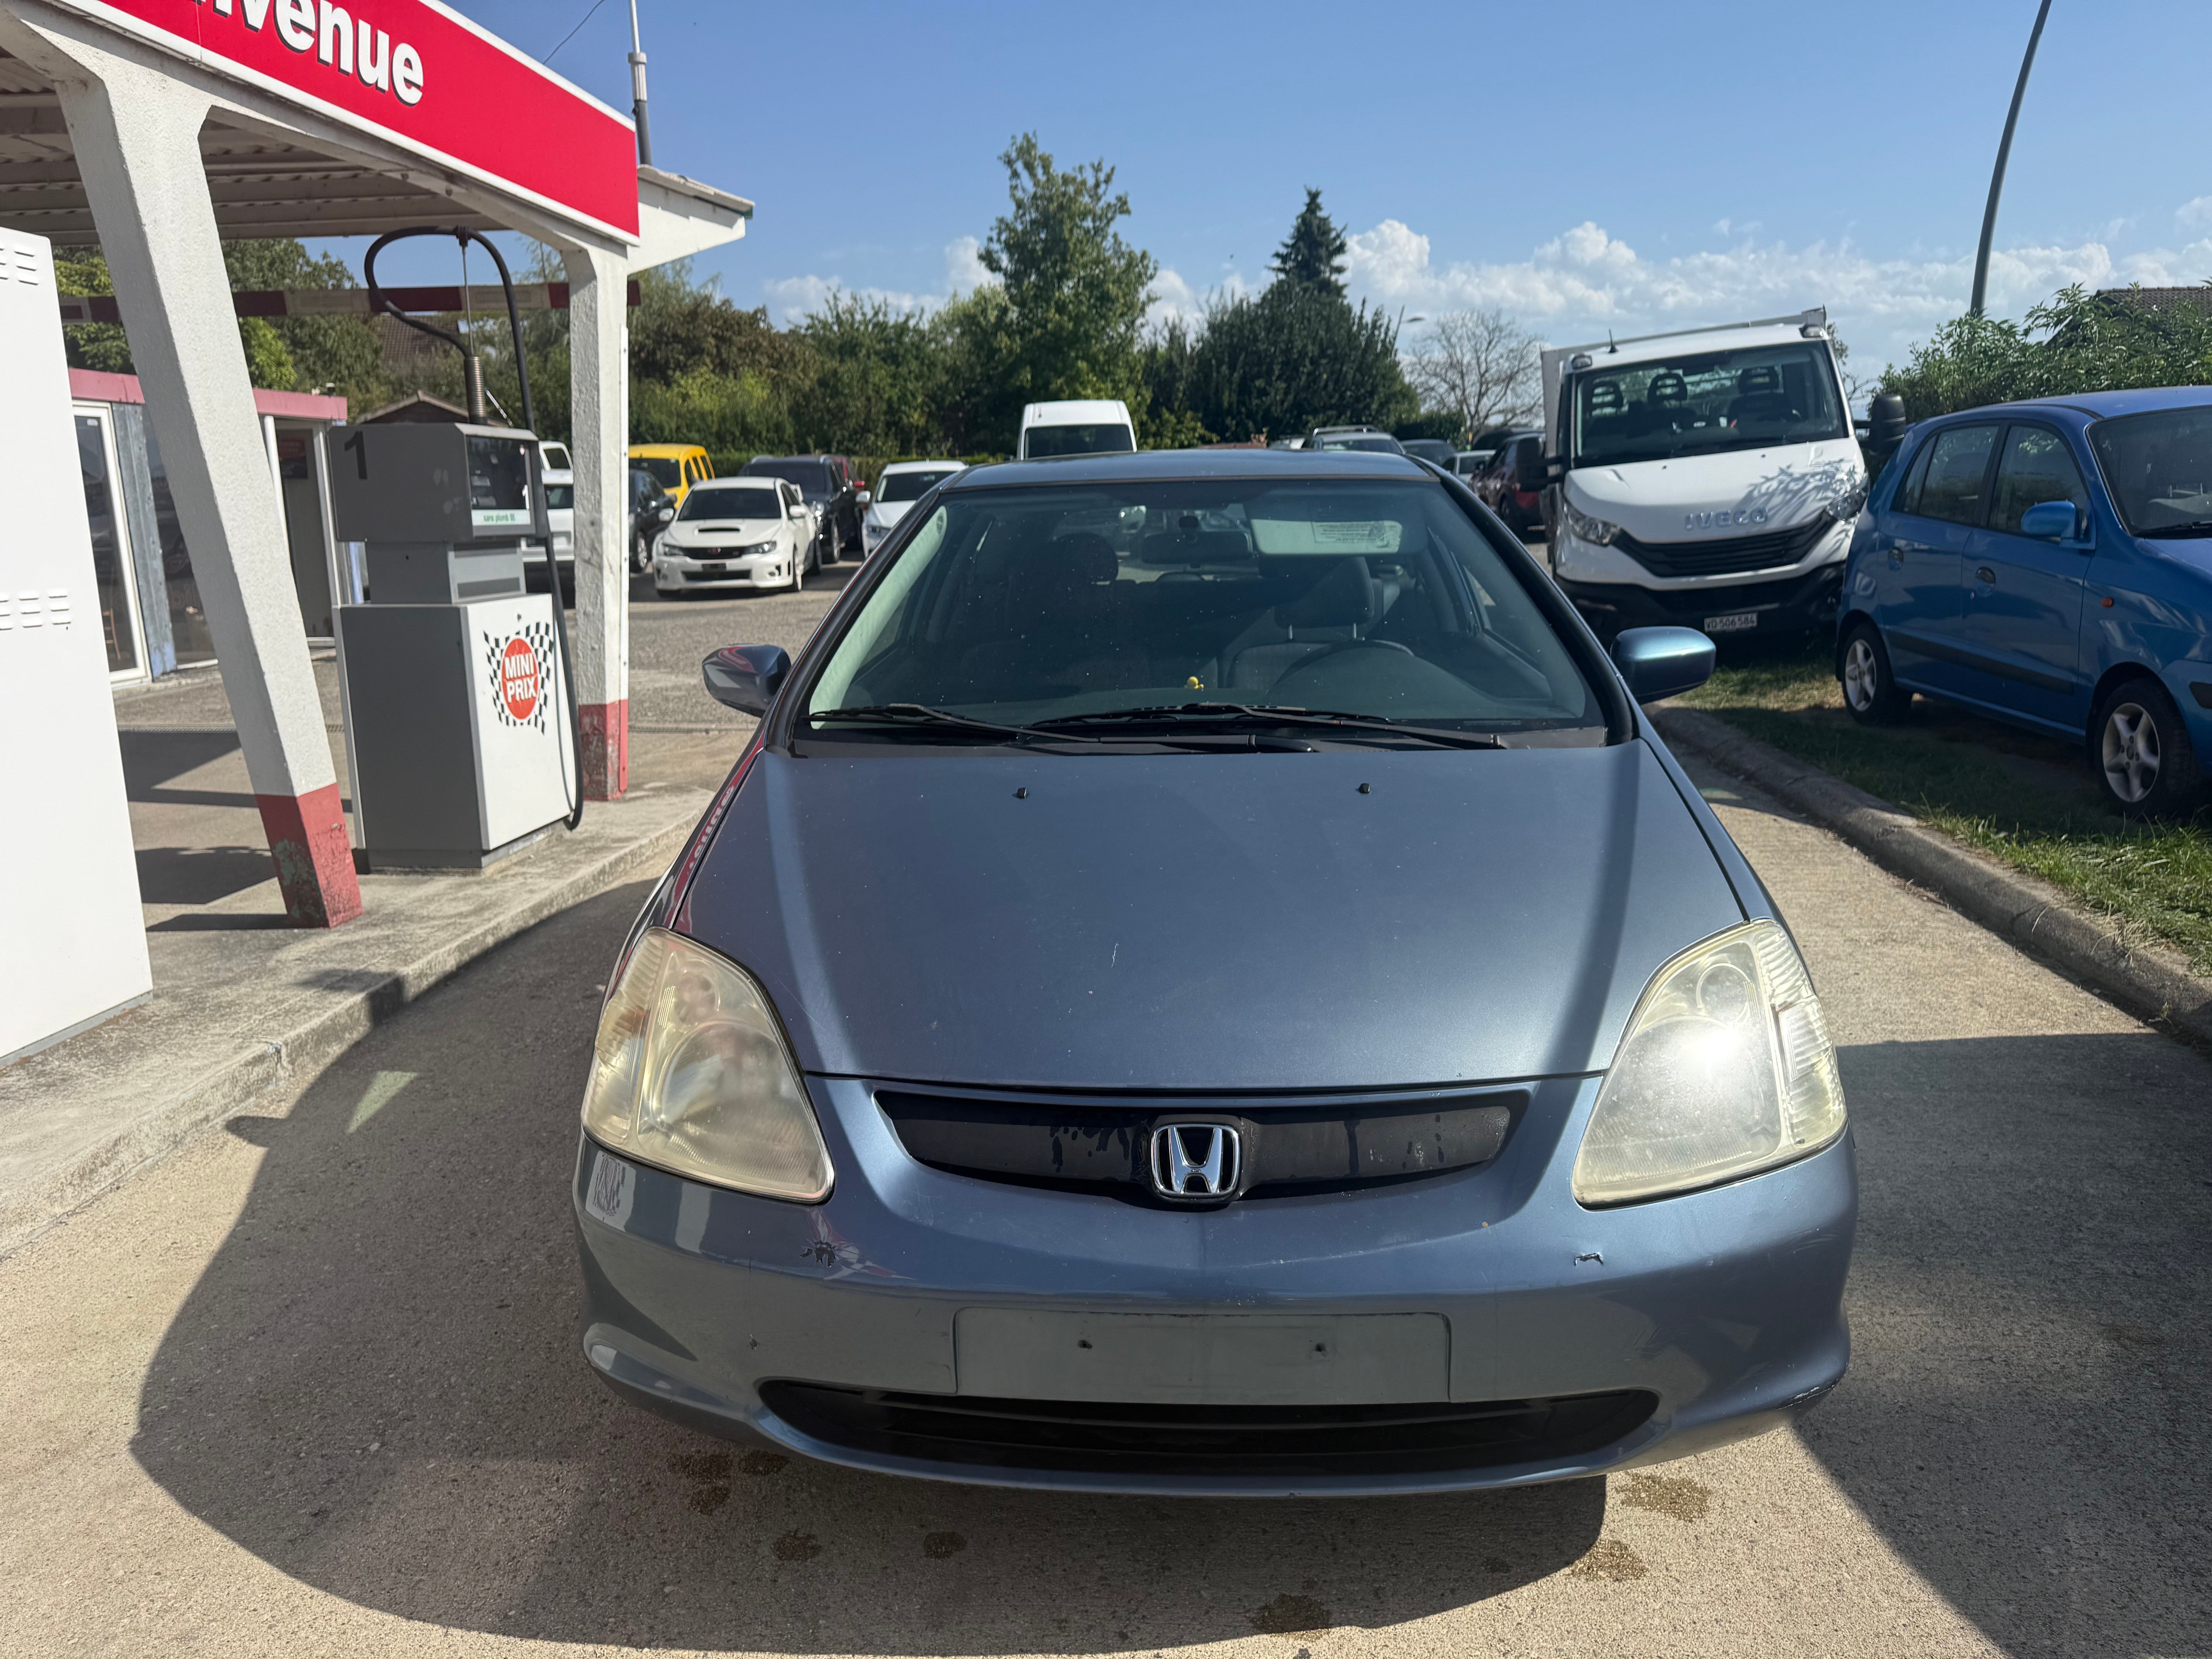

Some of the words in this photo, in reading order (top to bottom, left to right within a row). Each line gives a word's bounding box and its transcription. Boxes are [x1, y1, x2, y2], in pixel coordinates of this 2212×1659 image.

[344, 430, 368, 479] 1
[1685, 508, 1768, 531] IVECO
[504, 653, 534, 680] MINI
[507, 676, 537, 703] PRIX
